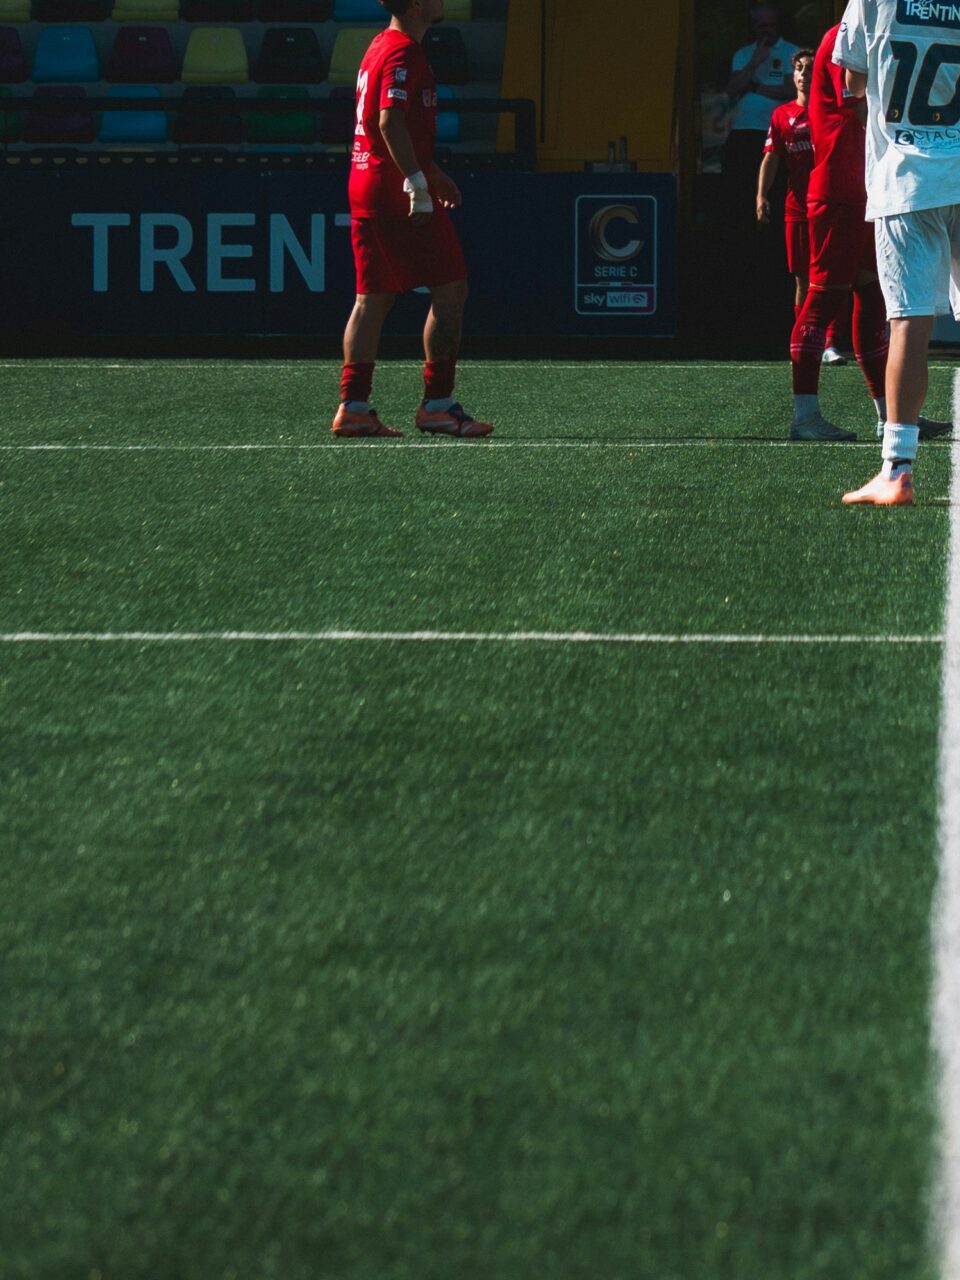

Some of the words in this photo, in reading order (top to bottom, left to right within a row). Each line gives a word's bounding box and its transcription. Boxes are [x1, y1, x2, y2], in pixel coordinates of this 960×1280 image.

[70, 212, 432, 294] TREN
[593, 266, 627, 278] SERIE
[629, 266, 638, 278] C
[583, 292, 606, 307] sky
[609, 292, 631, 305] wifi
